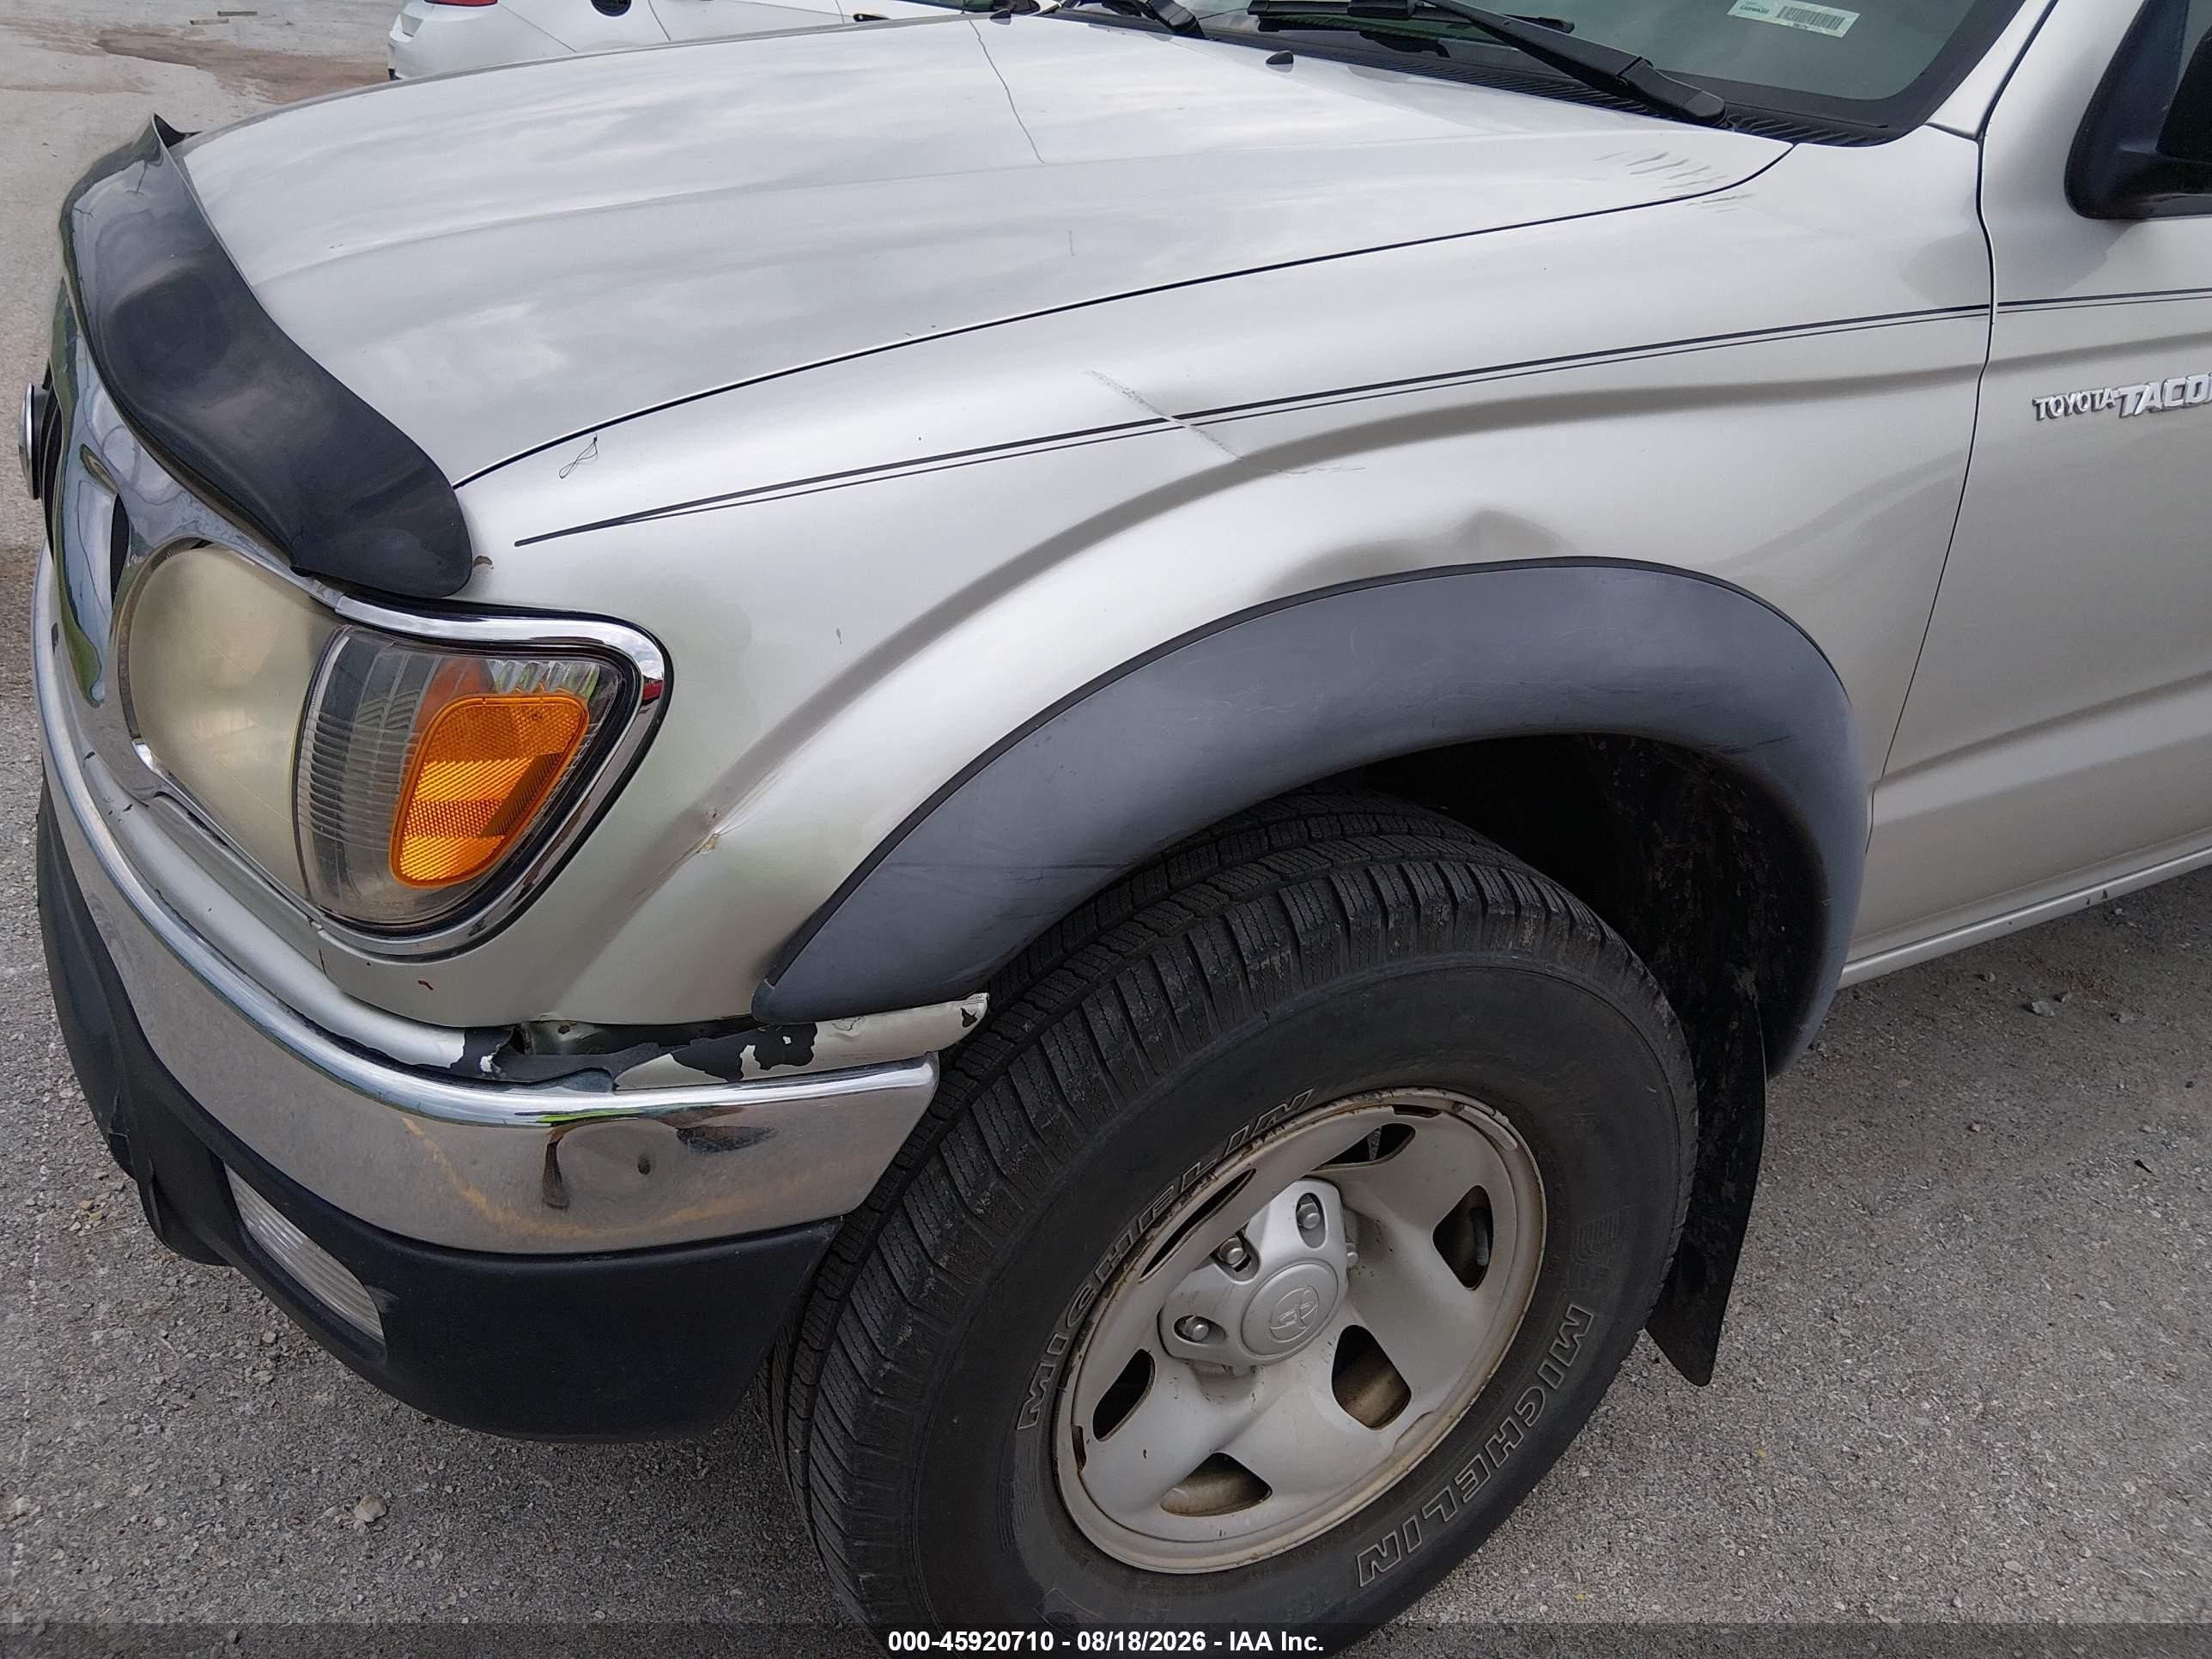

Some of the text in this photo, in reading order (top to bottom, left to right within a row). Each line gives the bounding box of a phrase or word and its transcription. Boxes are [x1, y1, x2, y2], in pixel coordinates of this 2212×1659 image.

[2033, 372, 2212, 421] TOYOTA TACO
[1017, 1088, 1315, 1431] MICHELIN
[1355, 1304, 1595, 1588] MICHELIN
